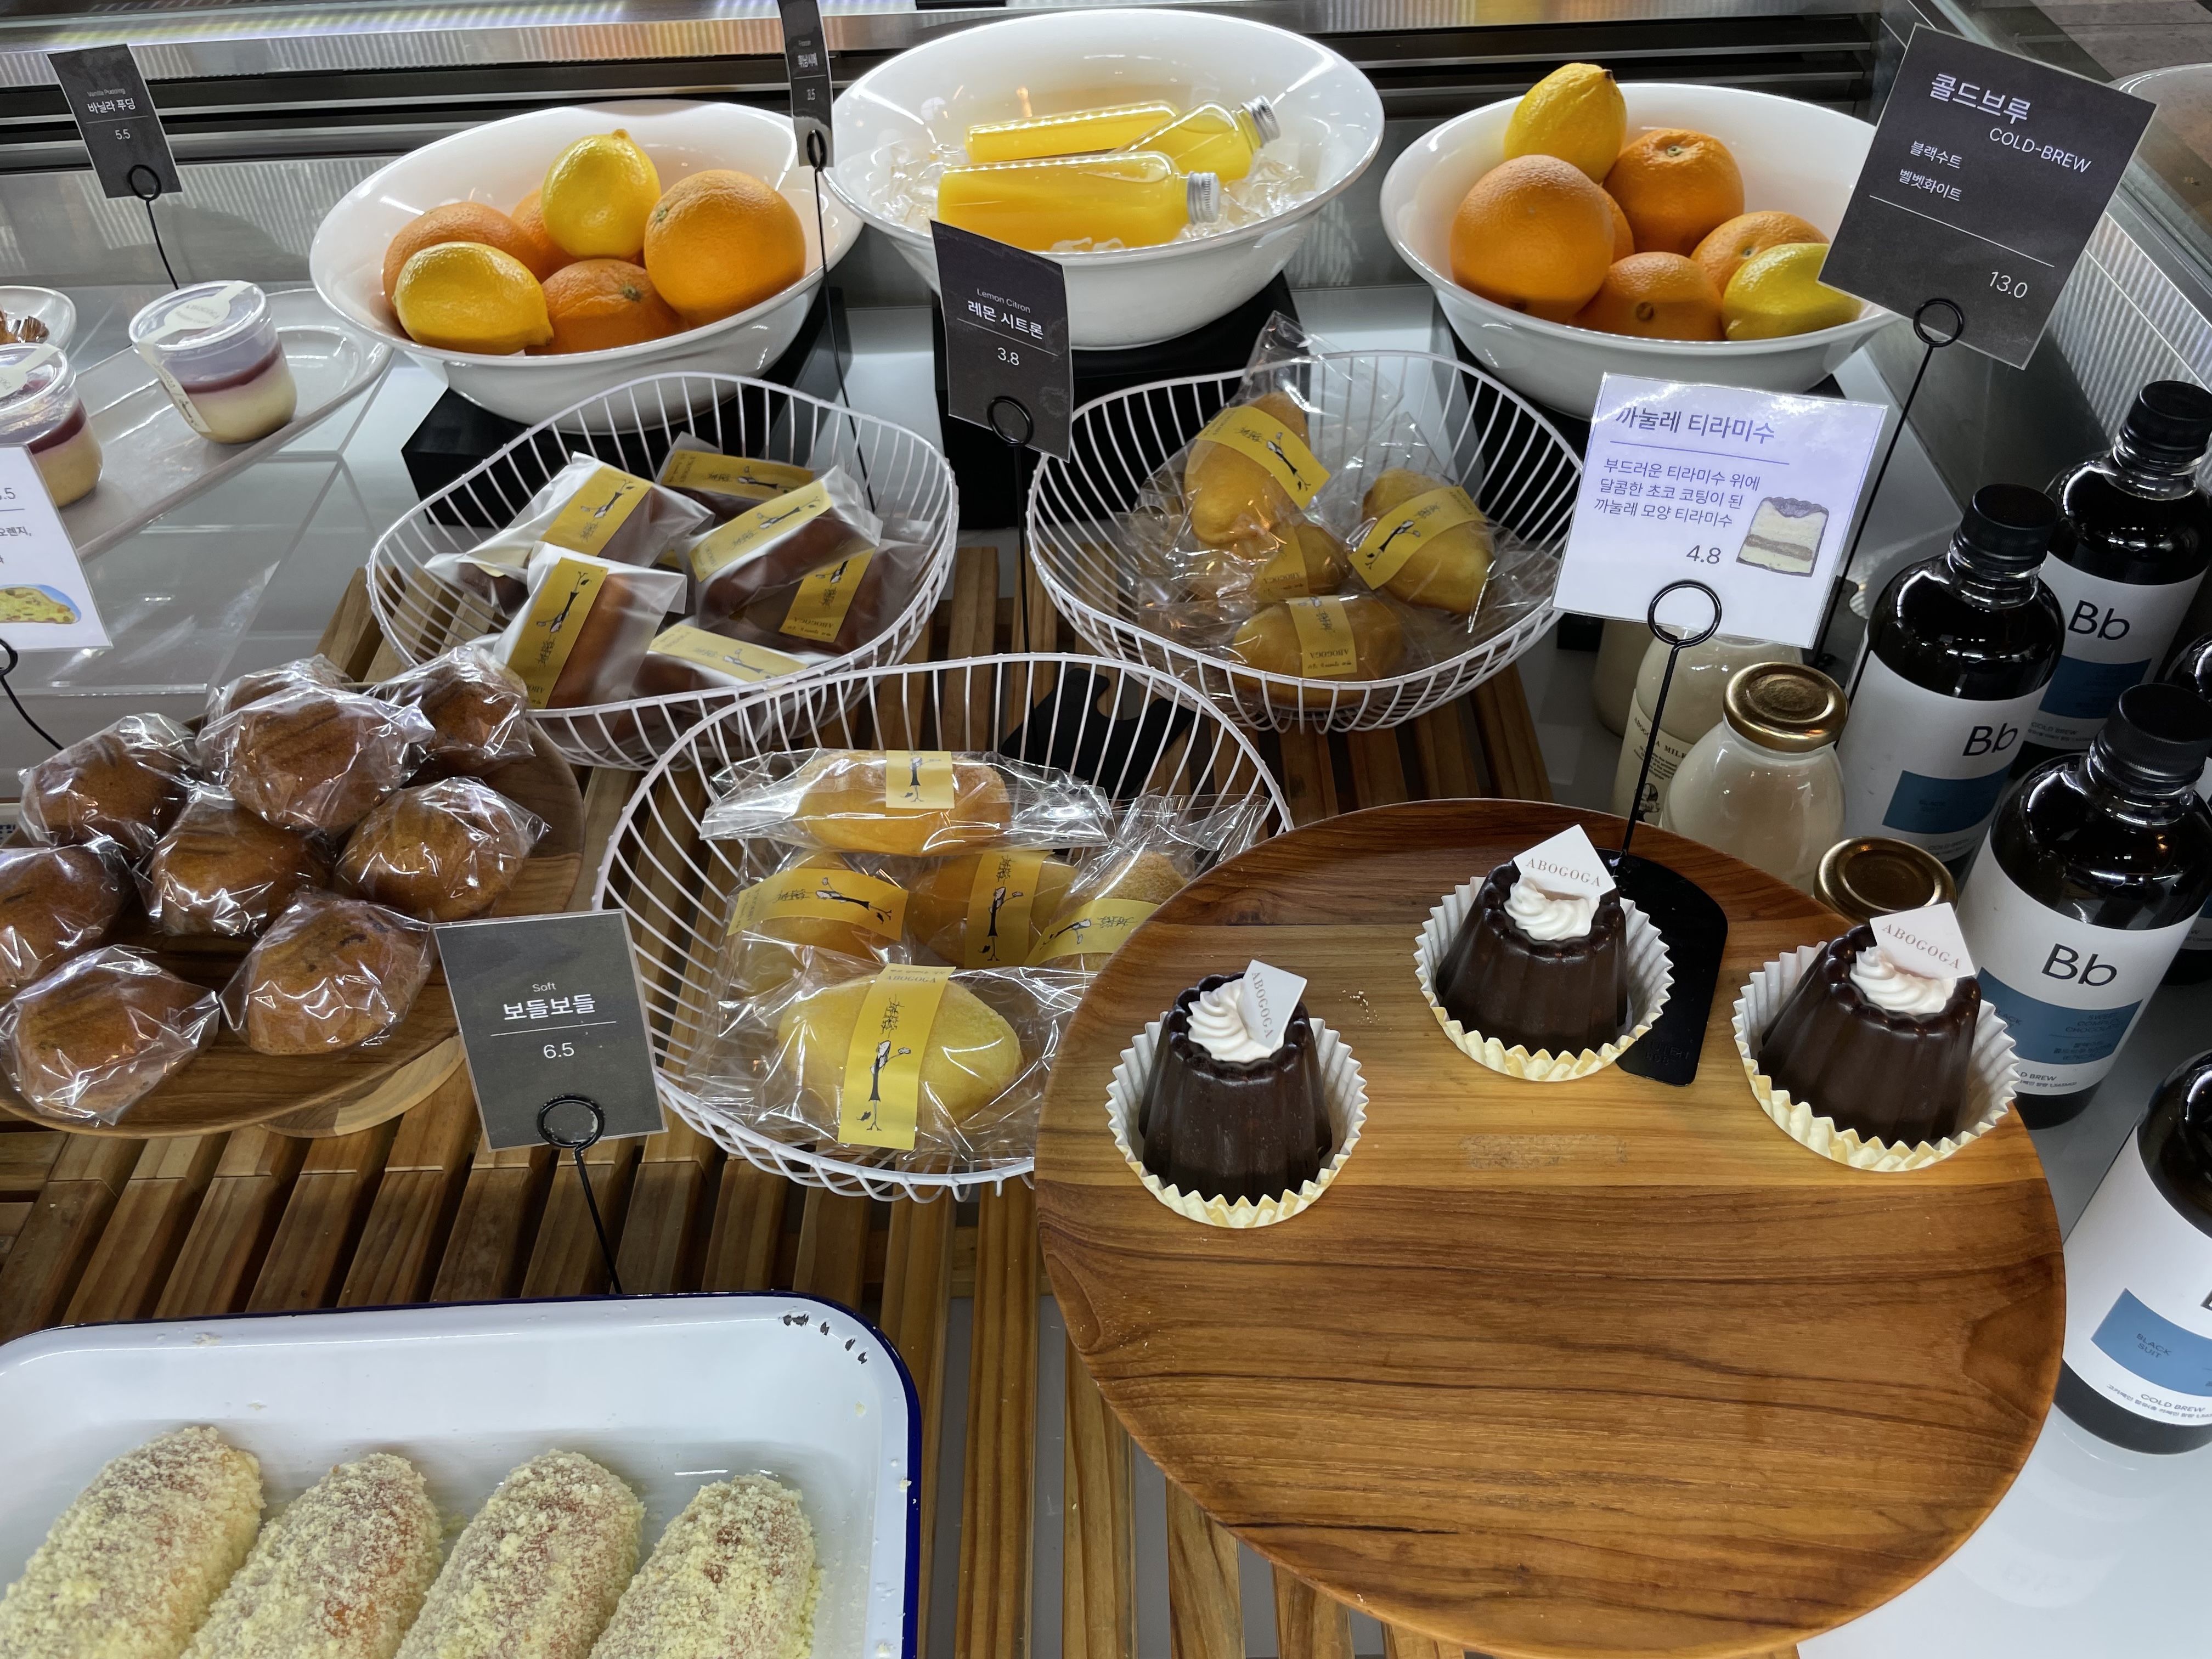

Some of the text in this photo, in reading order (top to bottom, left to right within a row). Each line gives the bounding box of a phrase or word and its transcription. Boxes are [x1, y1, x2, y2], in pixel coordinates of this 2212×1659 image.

[87, 98, 136, 114] 바닐라 푸딩
[1929, 73, 2030, 124] 콜드브루
[115, 129, 131, 140] 5.5
[1910, 140, 1962, 170] 블랙수트
[1989, 127, 2092, 173] COLD-BREW
[1899, 168, 1962, 201] 벨벳화이트
[1990, 272, 2028, 298] 13.0
[977, 288, 1031, 313] Lemon Citron
[968, 301, 1043, 340] 레몬 시트론
[997, 347, 1019, 366] 3.8
[1615, 406, 1775, 444] 까눌레 티라미수
[1604, 458, 1760, 491] 부드러운 티라미수 위에
[1600, 478, 1743, 510] 달콤한 초코 코팅이 된
[1594, 499, 1733, 528] 까눌레 모양 티라미수
[1686, 545, 1722, 564] 4.8
[2068, 600, 2130, 640] Bb
[1962, 723, 2018, 757] Bb
[1525, 858, 1600, 887] ABOGOGA
[1882, 923, 1960, 969] ABOGOGA
[887, 975, 936, 983] ABOGOGA
[2041, 943, 2117, 986] Bb
[532, 982, 556, 992] Soft
[503, 994, 595, 1020] 보들보들
[1251, 972, 1274, 1039] ABOGOGA
[543, 1042, 574, 1059] 6.5
[2136, 1333, 2172, 1356] BLACK
[2138, 1343, 2162, 1358] SUIT
[2141, 1394, 2171, 1407] COLD
